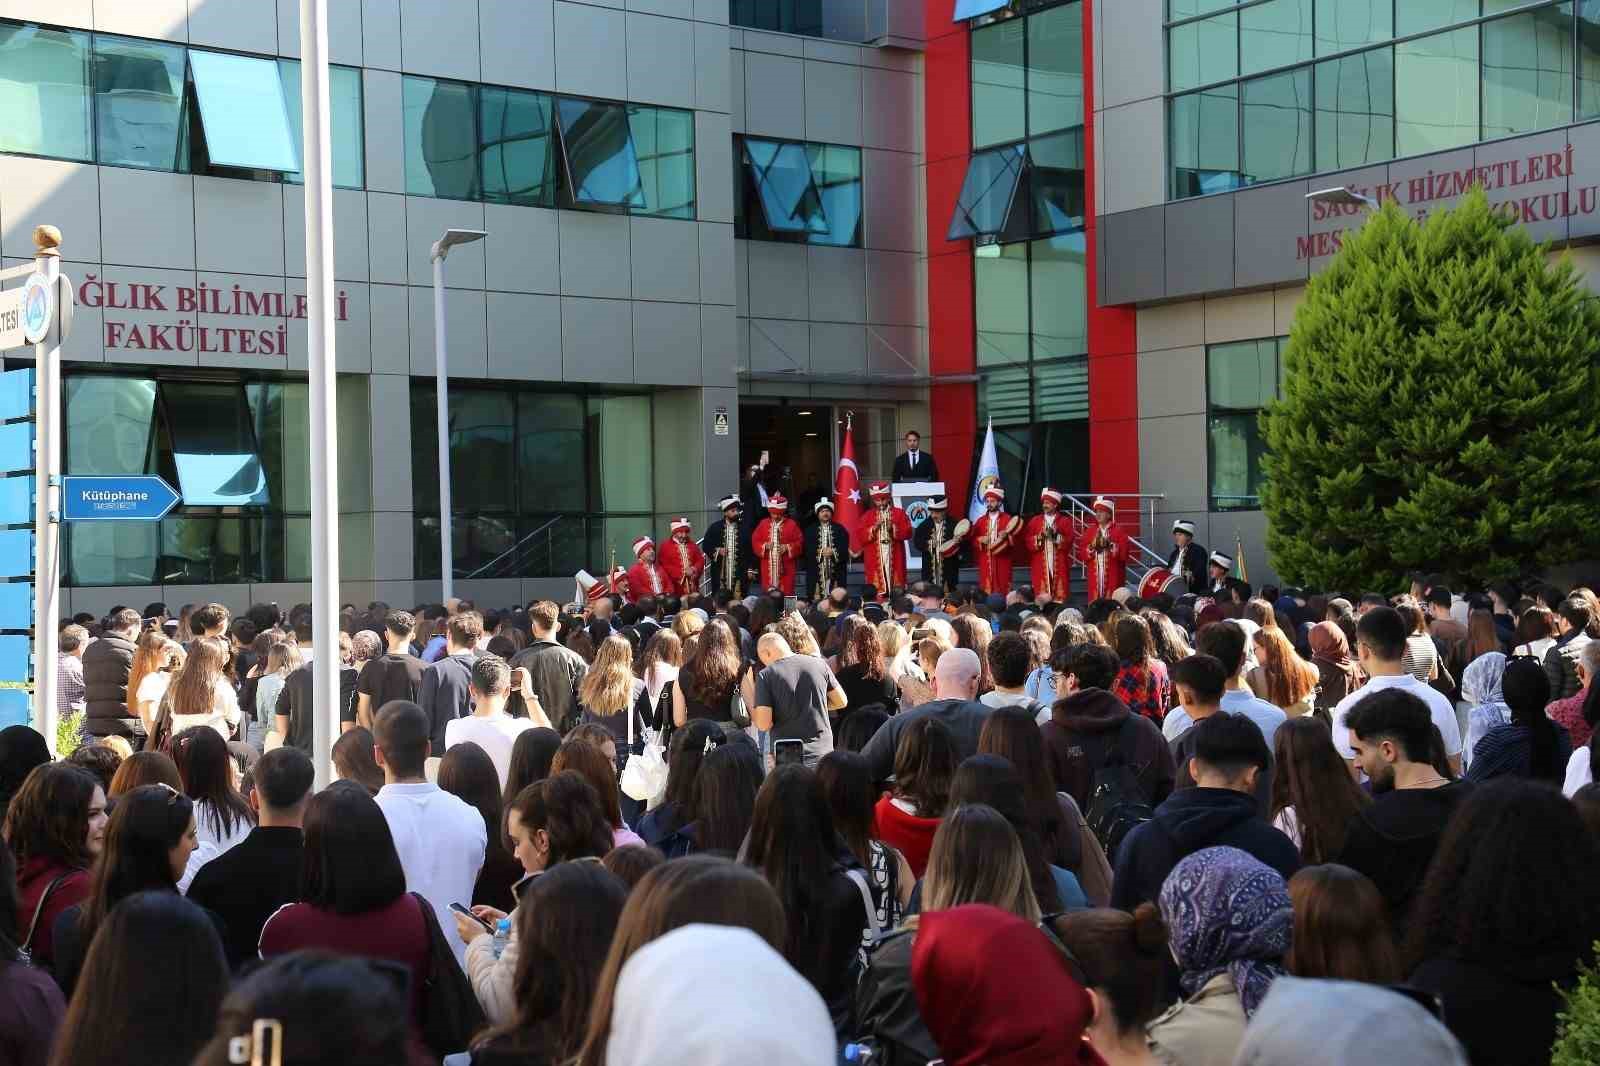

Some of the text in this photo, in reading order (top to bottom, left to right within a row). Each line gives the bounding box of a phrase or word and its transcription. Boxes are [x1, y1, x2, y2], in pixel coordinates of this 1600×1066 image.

[1312, 144, 1575, 222] SAĞIK HİZMETLERİ
[1295, 228, 1344, 261] MES
[74, 274, 350, 322] ĞLIK BİLİMLEİ
[0, 303, 20, 334] TESİ
[105, 320, 289, 356] FAKÜLTESİ
[82, 490, 149, 503] Kütüphane
